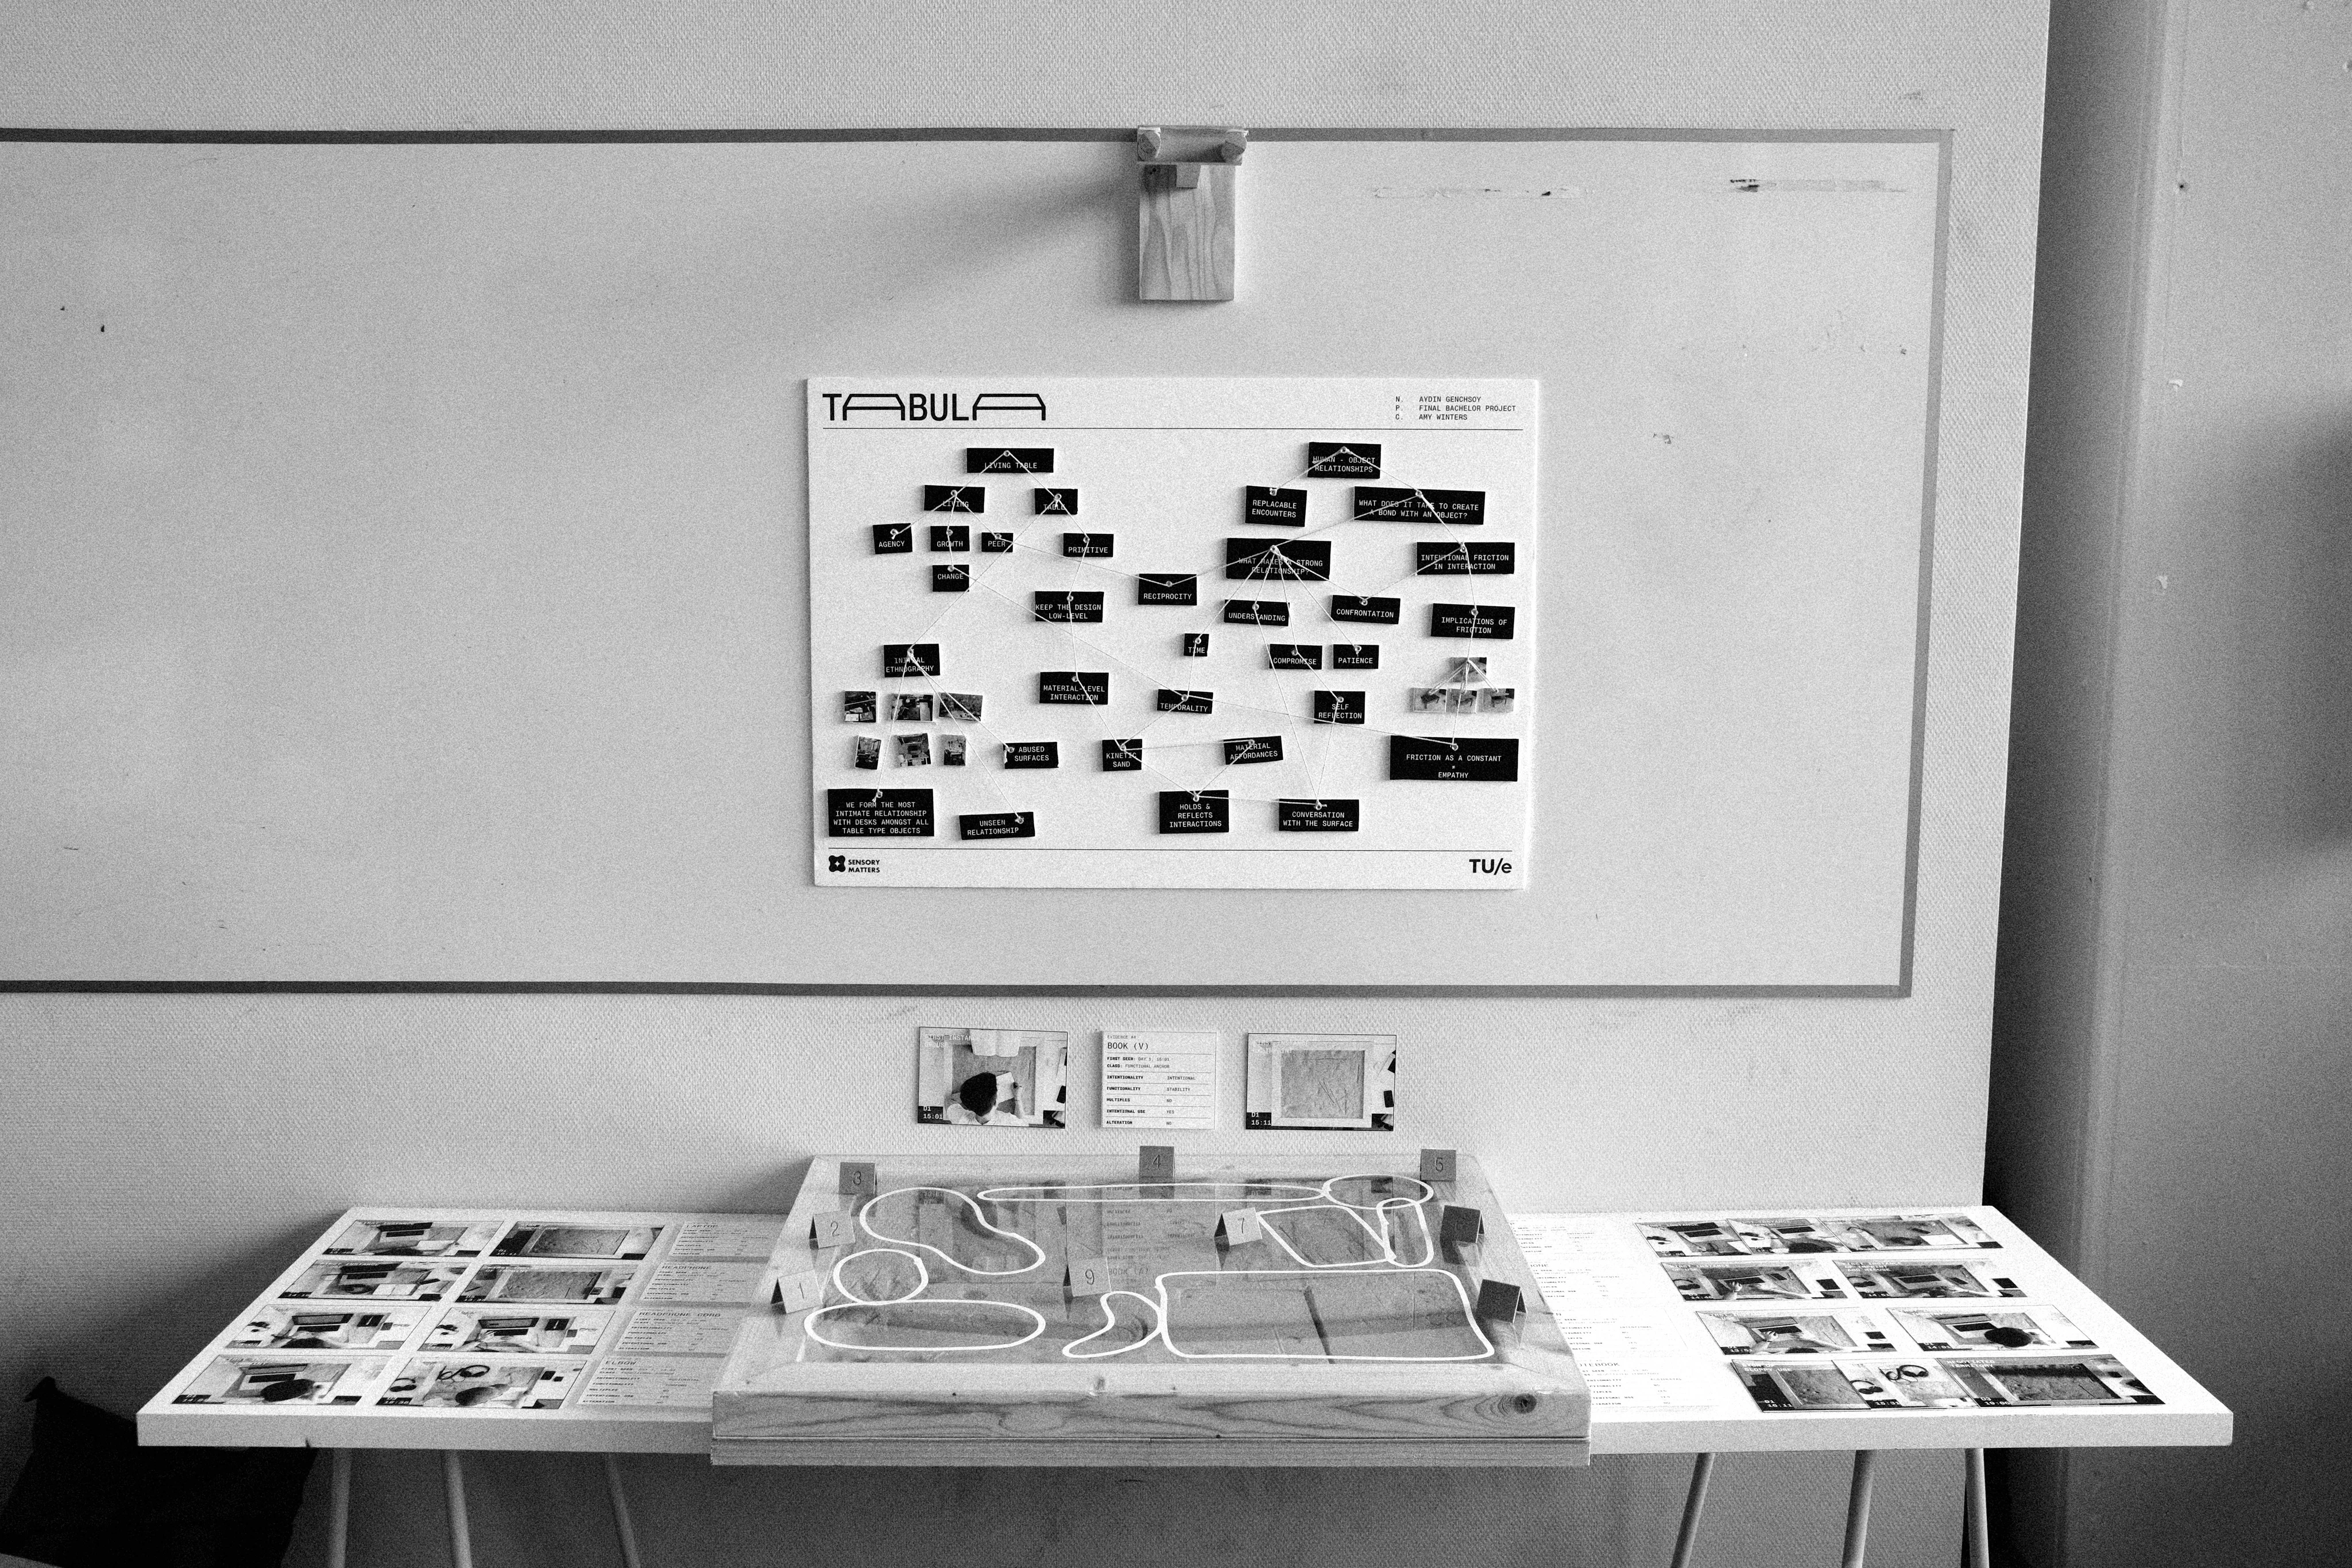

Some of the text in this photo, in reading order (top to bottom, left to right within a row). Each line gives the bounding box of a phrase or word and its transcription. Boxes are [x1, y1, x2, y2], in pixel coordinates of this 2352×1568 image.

[823, 393, 1046, 421] TABULA
[1252, 501, 1297, 509] REPLACABLE
[1252, 509, 1297, 518] ENCOUNTERS
[1296, 559, 1323, 567] STRONG
[1252, 567, 1310, 576] RELATIONSHIP?
[1228, 613, 1286, 622] UNDERSTANDING
[1336, 609, 1394, 618] CONFRONTATION
[1441, 617, 1495, 625] IMPLICATIONS
[894, 657, 924, 665] INITAL
[1273, 657, 1317, 665] COMPROMISE
[1338, 657, 1373, 665] PATIENCE
[1043, 685, 1105, 693] MATERIAL-LEVEL
[1050, 694, 1098, 702] INTERACTION
[1160, 703, 1208, 713] TEMPORALITY
[1318, 711, 1362, 720] REFLECTION
[1236, 743, 1271, 751] MATERIAL
[1014, 754, 1050, 762] SURFACES
[1106, 752, 1136, 760] KINETIC
[1230, 750, 1278, 760] AFFORDANCES
[1406, 754, 1442, 762] FRICTION
[1467, 754, 1502, 762] CONSTANT
[1438, 771, 1469, 780] EMPATHY
[835, 810, 927, 818] INTIMATE RELATIONSHIP
[1292, 811, 1345, 819] CONVERSATION
[1283, 819, 1353, 828] WITH THE SURFACE
[842, 827, 920, 835] TABLE TYPE OBJECTS
[967, 827, 1019, 837] RELATIONSHIP
[1469, 858, 1512, 876] TU/e
[1152, 1154, 1162, 1170] 4
[1435, 1157, 1444, 1172] 5
[852, 1171, 862, 1185] 3
[830, 1221, 839, 1237] 2
[1236, 1217, 1245, 1233] 7
[1085, 1268, 1095, 1286] 9
[797, 1282, 804, 1299] 1
